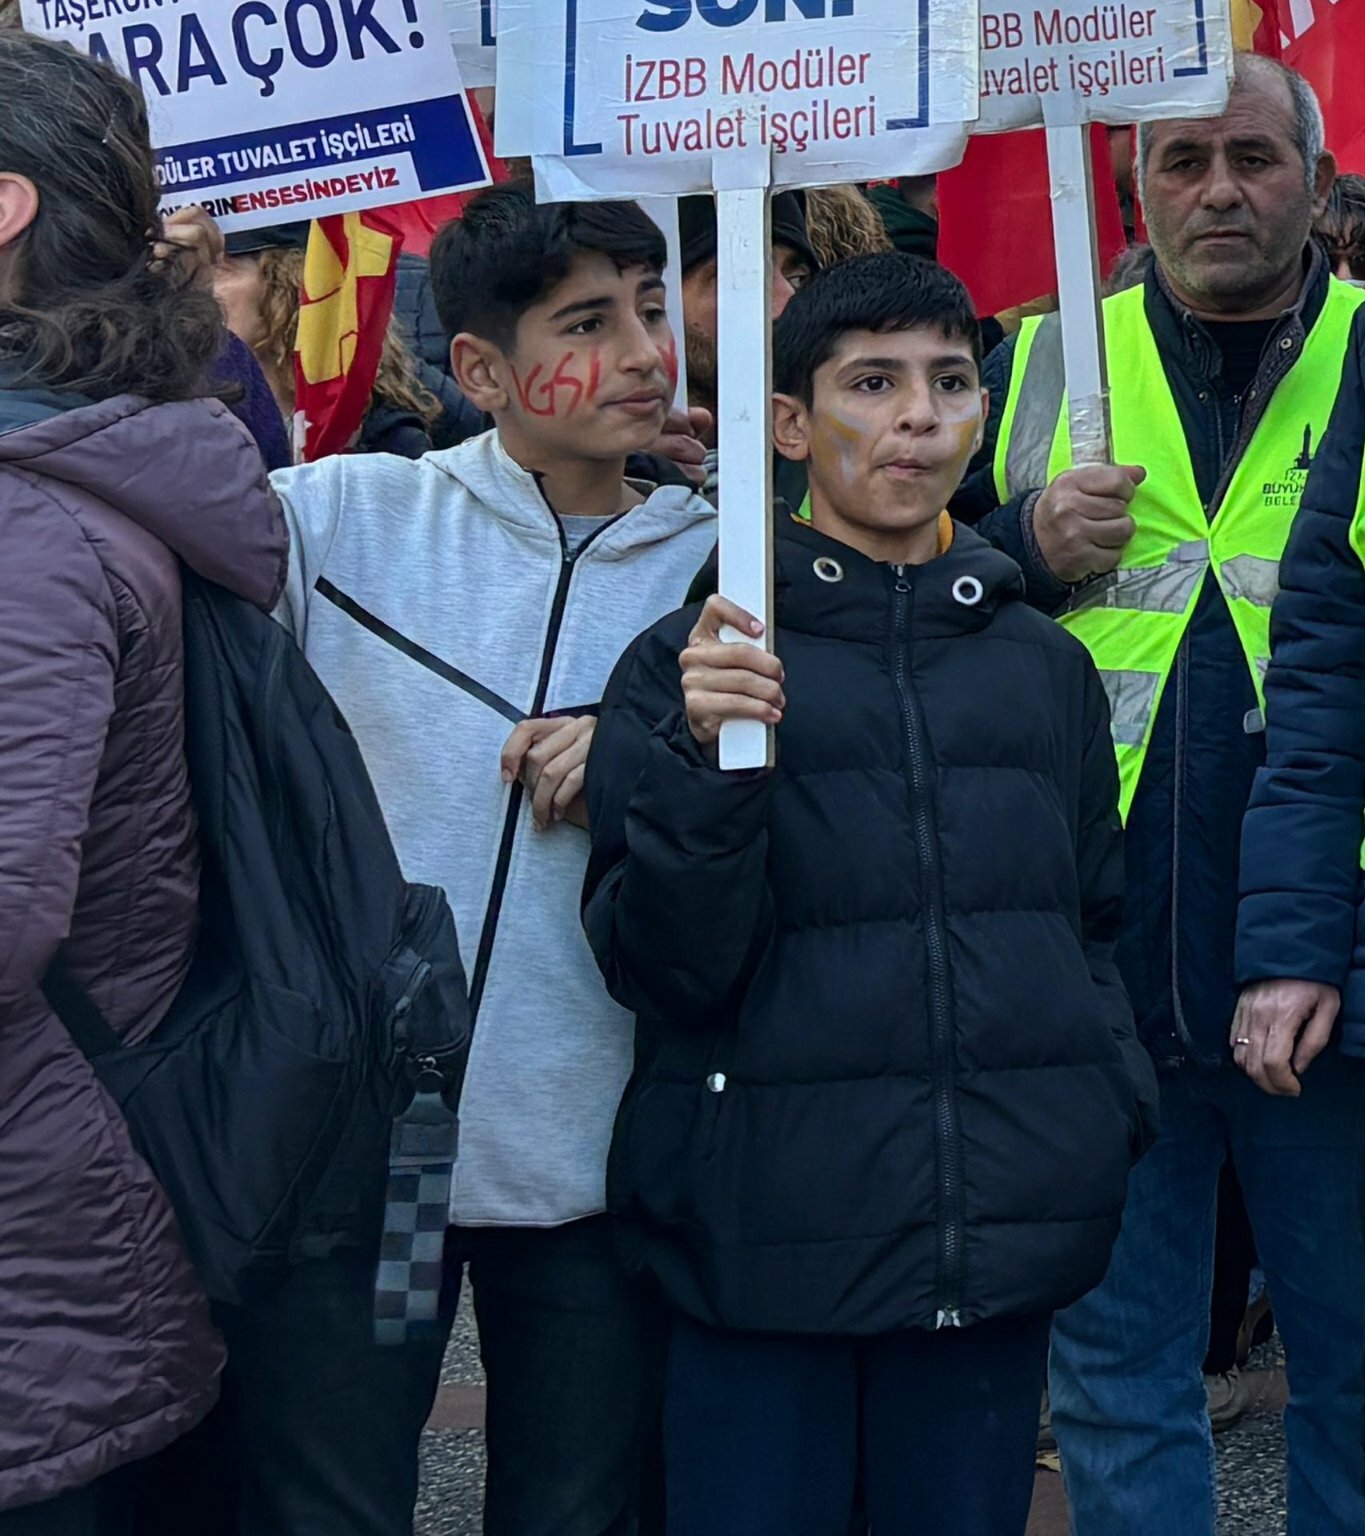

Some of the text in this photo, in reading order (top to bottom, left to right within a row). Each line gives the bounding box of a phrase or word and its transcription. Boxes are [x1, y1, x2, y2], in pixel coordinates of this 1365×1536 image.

[1035, 5, 1157, 46] Modüler
[625, 46, 872, 103] İZBB Modüler
[1068, 49, 1166, 98] işçileri
[152, 114, 416, 186] DÜLER TUVALET İŞÇİLERİ
[617, 97, 877, 156] Tuvalet işçileri
